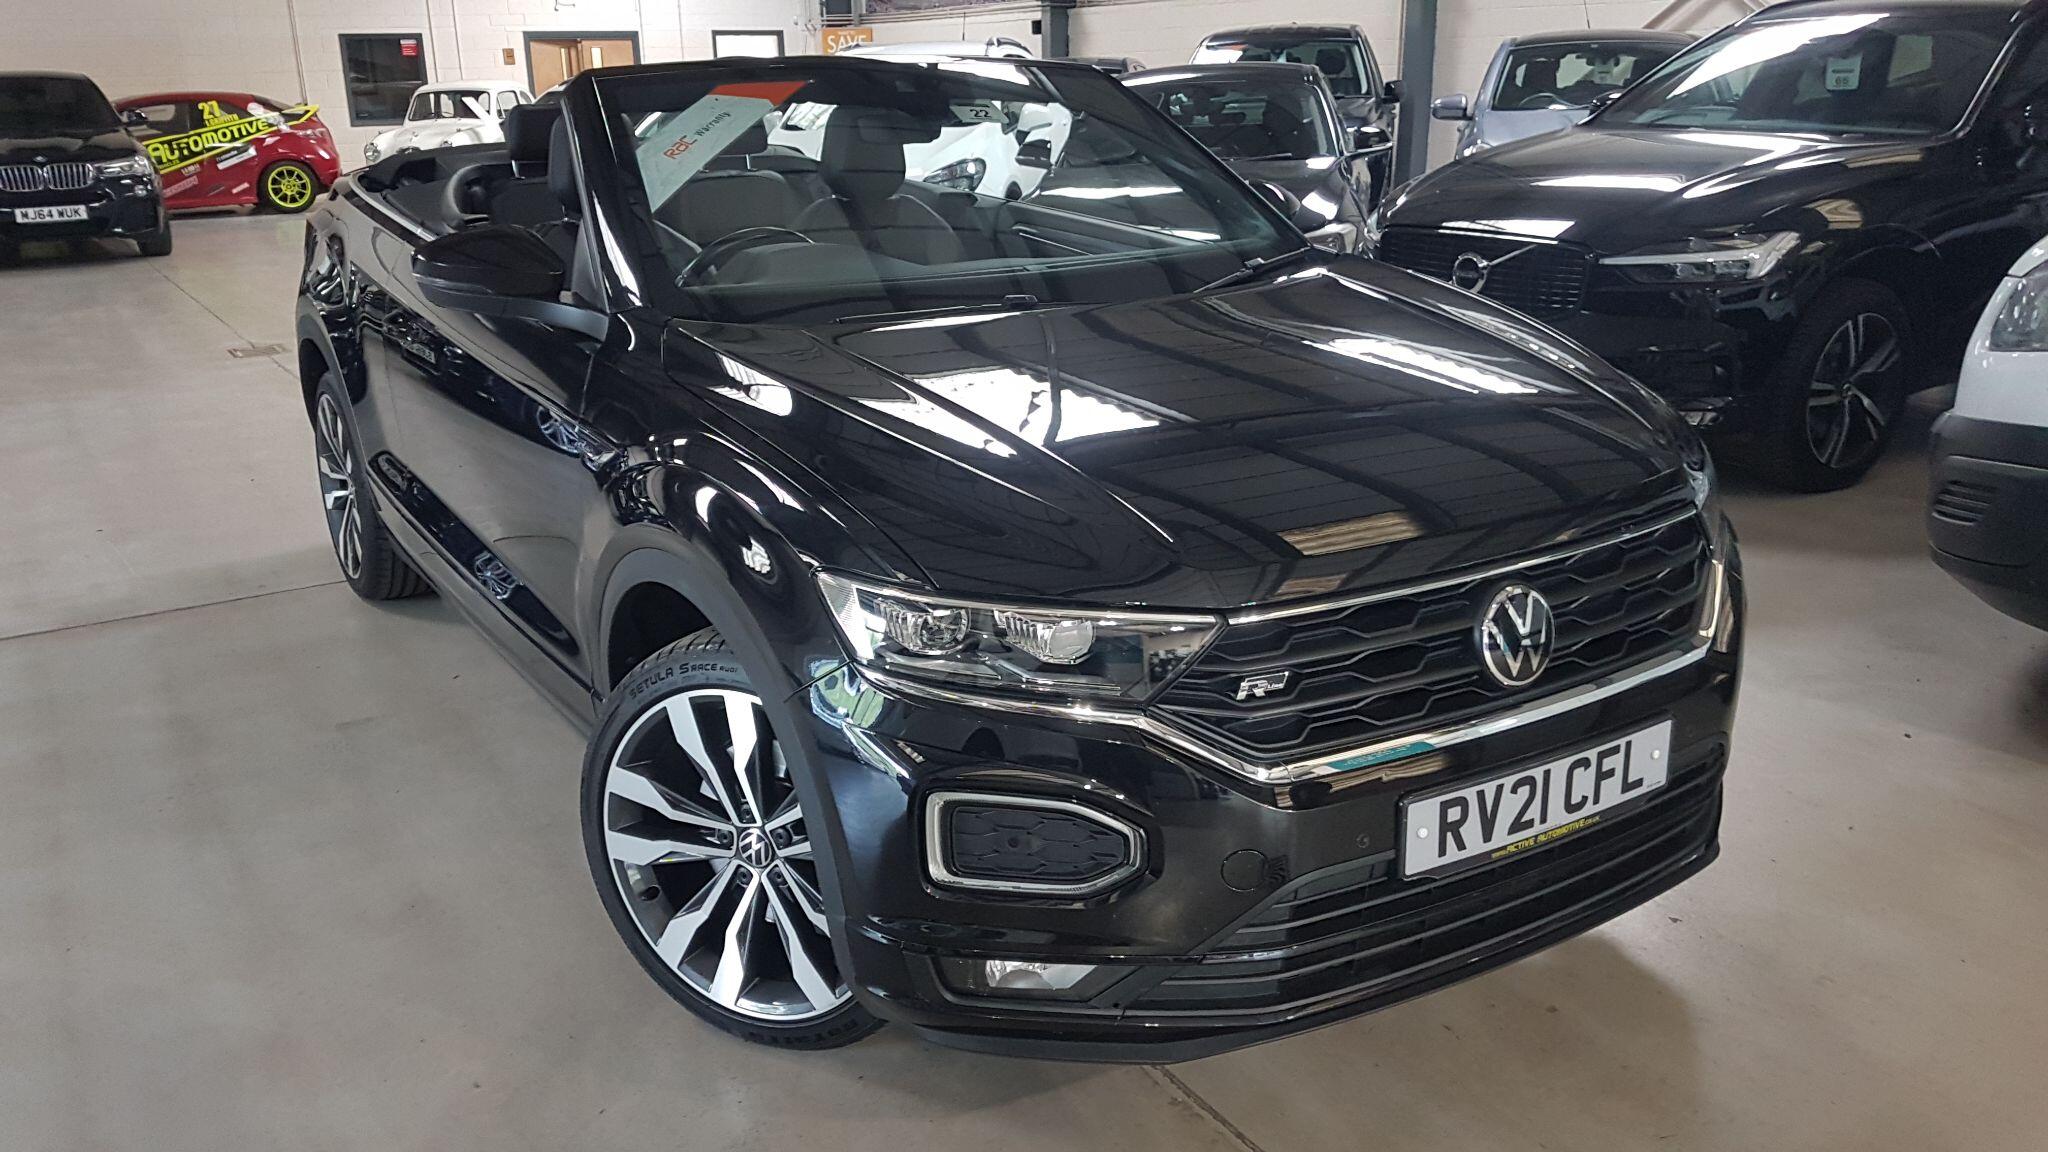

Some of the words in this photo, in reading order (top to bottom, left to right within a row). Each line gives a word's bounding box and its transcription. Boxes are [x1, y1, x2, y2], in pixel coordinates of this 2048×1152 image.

[694, 111, 731, 137] Warranty
[969, 109, 992, 118] 22
[1437, 769, 1550, 858] RV21
[1563, 740, 1644, 815] CFL
